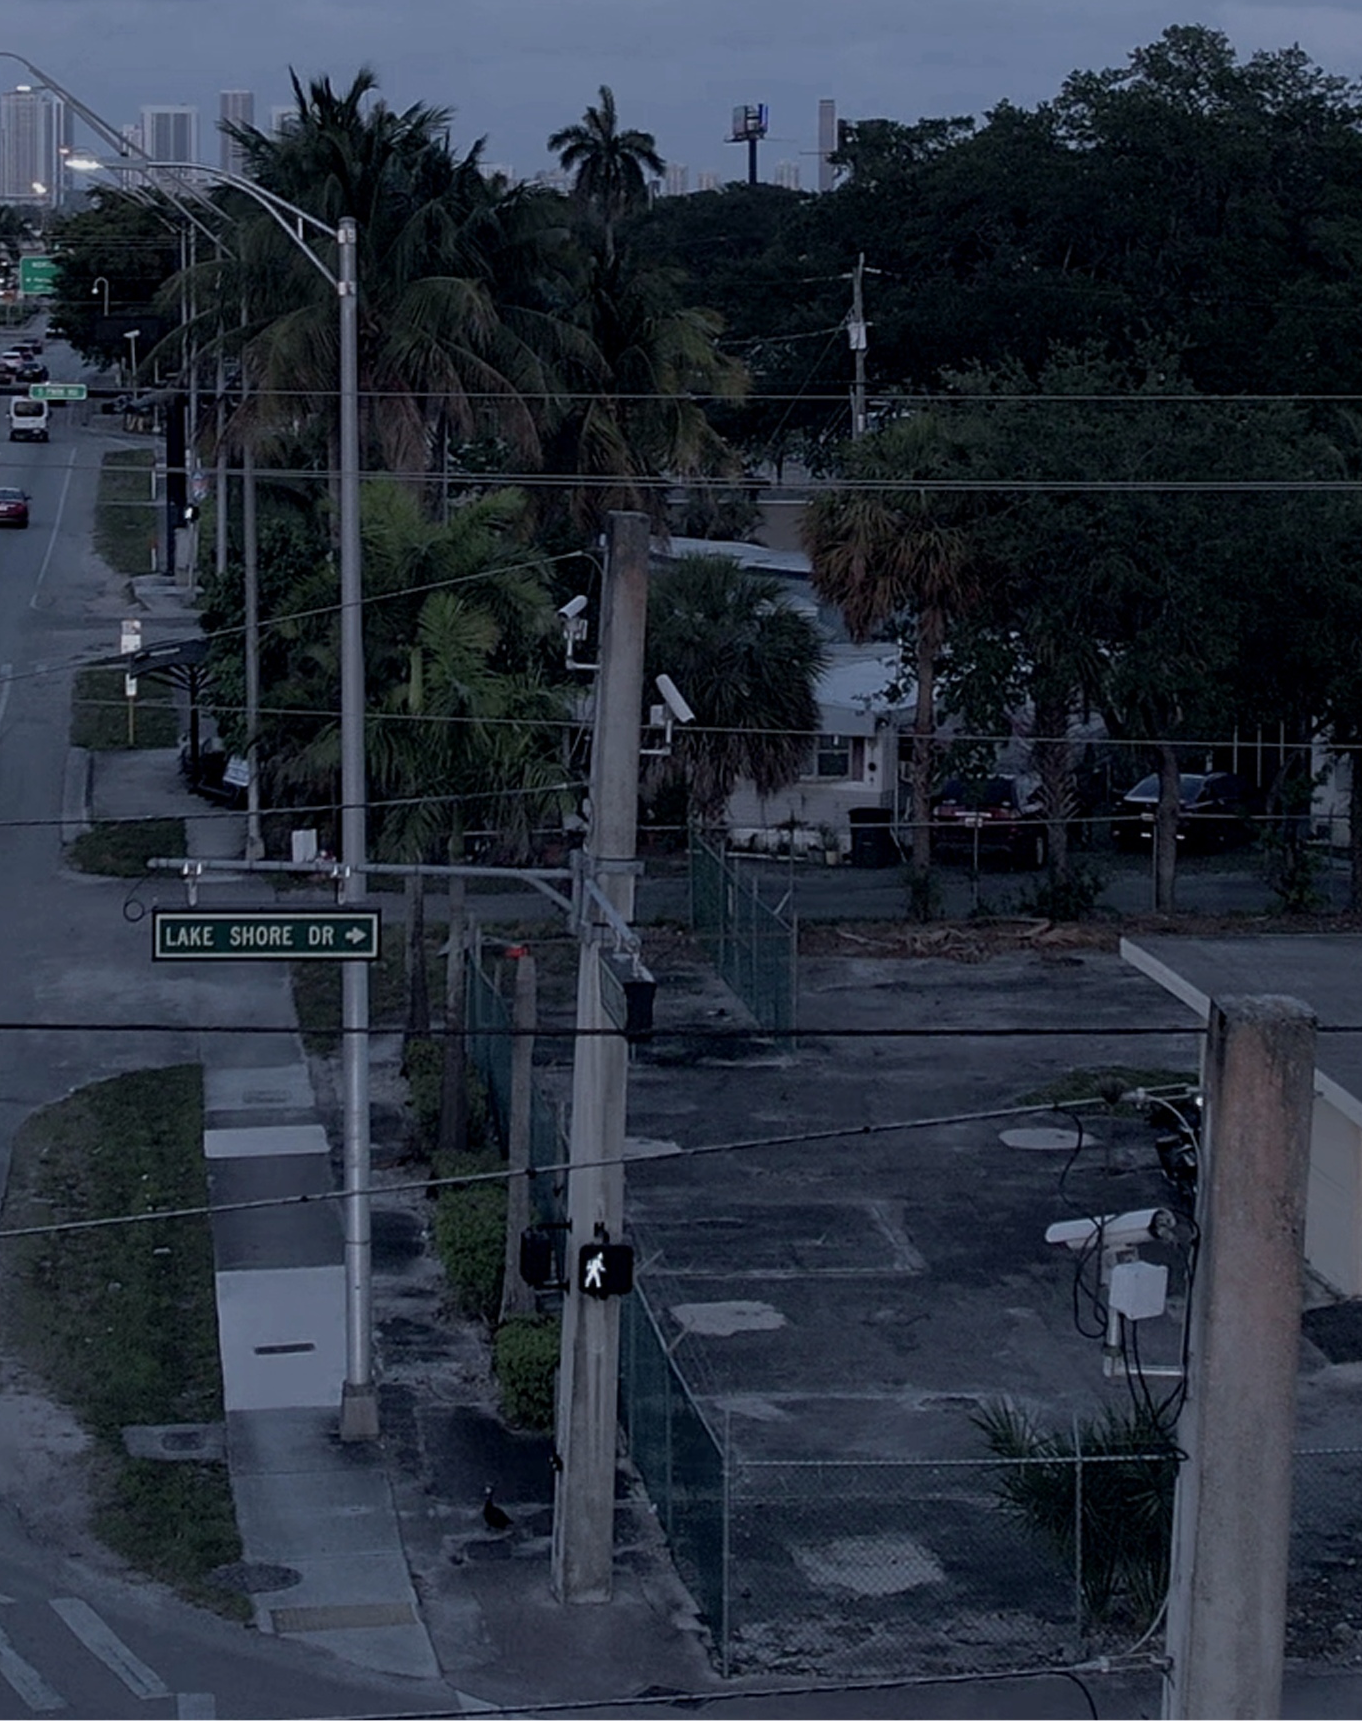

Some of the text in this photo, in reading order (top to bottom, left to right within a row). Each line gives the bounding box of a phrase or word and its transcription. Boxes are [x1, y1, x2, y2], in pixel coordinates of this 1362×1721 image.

[165, 926, 335, 946] LAKE SHORE DR
